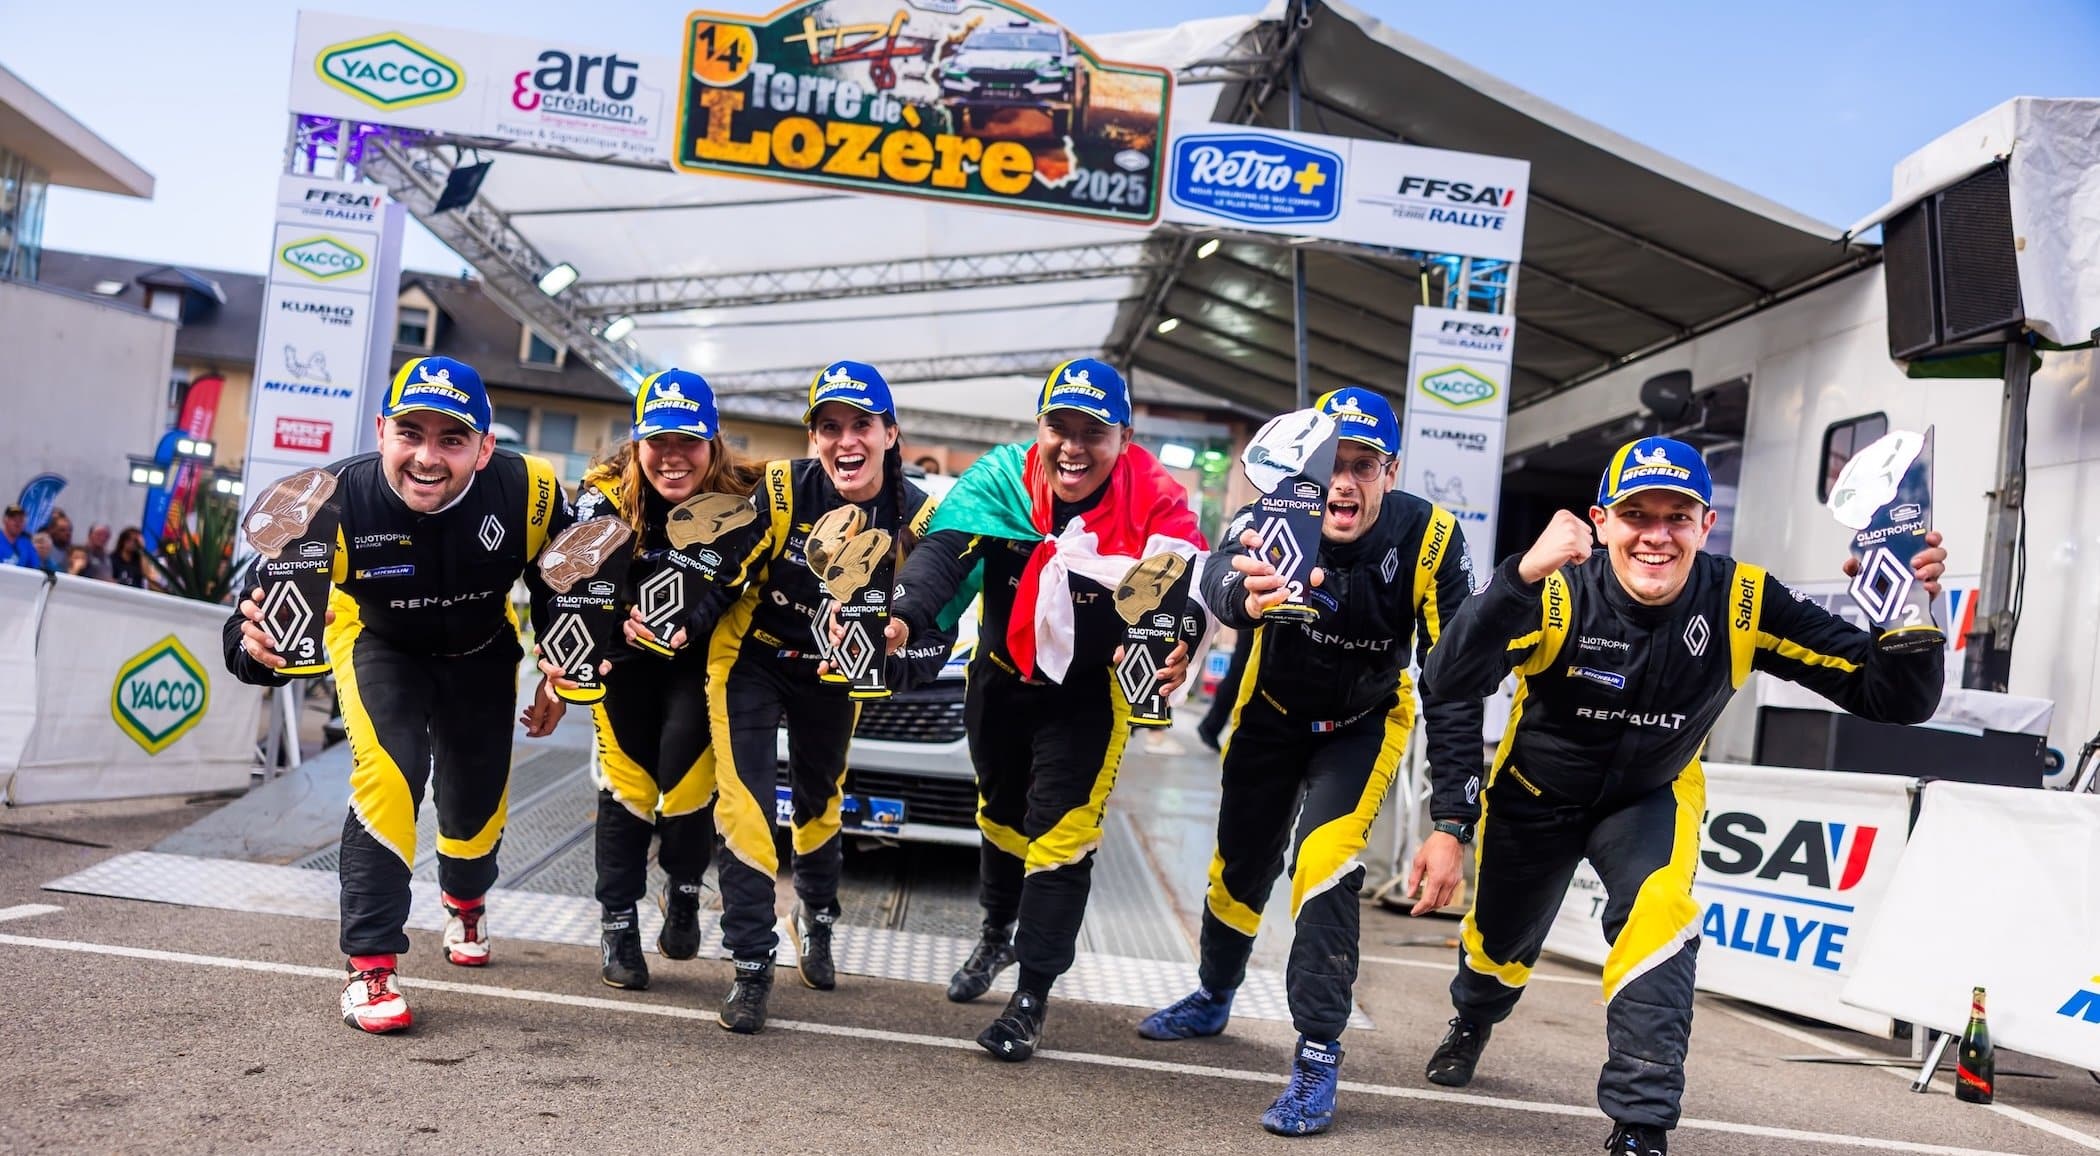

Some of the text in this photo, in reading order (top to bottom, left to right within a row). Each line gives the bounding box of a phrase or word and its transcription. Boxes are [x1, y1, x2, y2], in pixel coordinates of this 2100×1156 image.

[699, 25, 743, 72] 14
[341, 58, 443, 89] YACCO
[534, 50, 639, 101] art
[749, 64, 901, 124] Terre de
[695, 89, 1036, 195] Lozère
[1070, 169, 1147, 206] 2025
[1398, 176, 1499, 207] FFSA
[305, 189, 370, 207] FFSA
[325, 209, 375, 222] RALLYE
[1429, 208, 1505, 231] RALLYE
[292, 249, 355, 269] YACCO
[281, 300, 354, 318] KUMHO
[321, 316, 353, 327] TIRE
[1441, 320, 1502, 338] FFSA
[263, 380, 353, 399] MICHELIN
[404, 384, 470, 405] MICHELIN
[815, 381, 867, 398] MICHELIN
[1051, 384, 1106, 401] MICHELIN
[1432, 380, 1488, 396] YACCO
[644, 401, 699, 413] MICHELIN
[1420, 428, 1488, 443] KUMHO
[1456, 443, 1486, 452] TIRE
[1622, 465, 1689, 481] MICHELIN
[772, 468, 789, 513] Sabelt
[531, 475, 550, 527] Sabelt
[1262, 497, 1321, 511] CLIOTROPHY
[914, 505, 938, 539] abelt
[1857, 520, 1925, 542] CLIOTROPHY
[354, 533, 412, 545] CLIOTROPHY
[1422, 518, 1448, 571] Sabelt
[267, 560, 329, 571] CLIOTROPHY
[669, 549, 718, 577] CLIOTROPHY
[389, 590, 494, 609] RENAULT
[556, 596, 615, 606] CLIOTROPHY
[1287, 580, 1304, 603] 2
[840, 605, 887, 613] CLIOTROPHY
[1548, 577, 1564, 632] Sabelt
[1735, 577, 1757, 633] Sabelt
[1901, 604, 1923, 627] 2
[662, 622, 675, 640] 1
[1128, 627, 1175, 638] CLIOTROPHY
[1300, 622, 1393, 651] RENAULT
[299, 637, 316, 658] 3
[577, 663, 594, 682] 3
[869, 668, 879, 686] 1
[1583, 670, 1621, 684] MICHELIN
[131, 679, 197, 712] YACCO
[1150, 694, 1160, 713] 1
[1576, 707, 1687, 730] RENAULT
[1702, 902, 1849, 972] ALLYE
[1302, 1047, 1336, 1063] sparco
